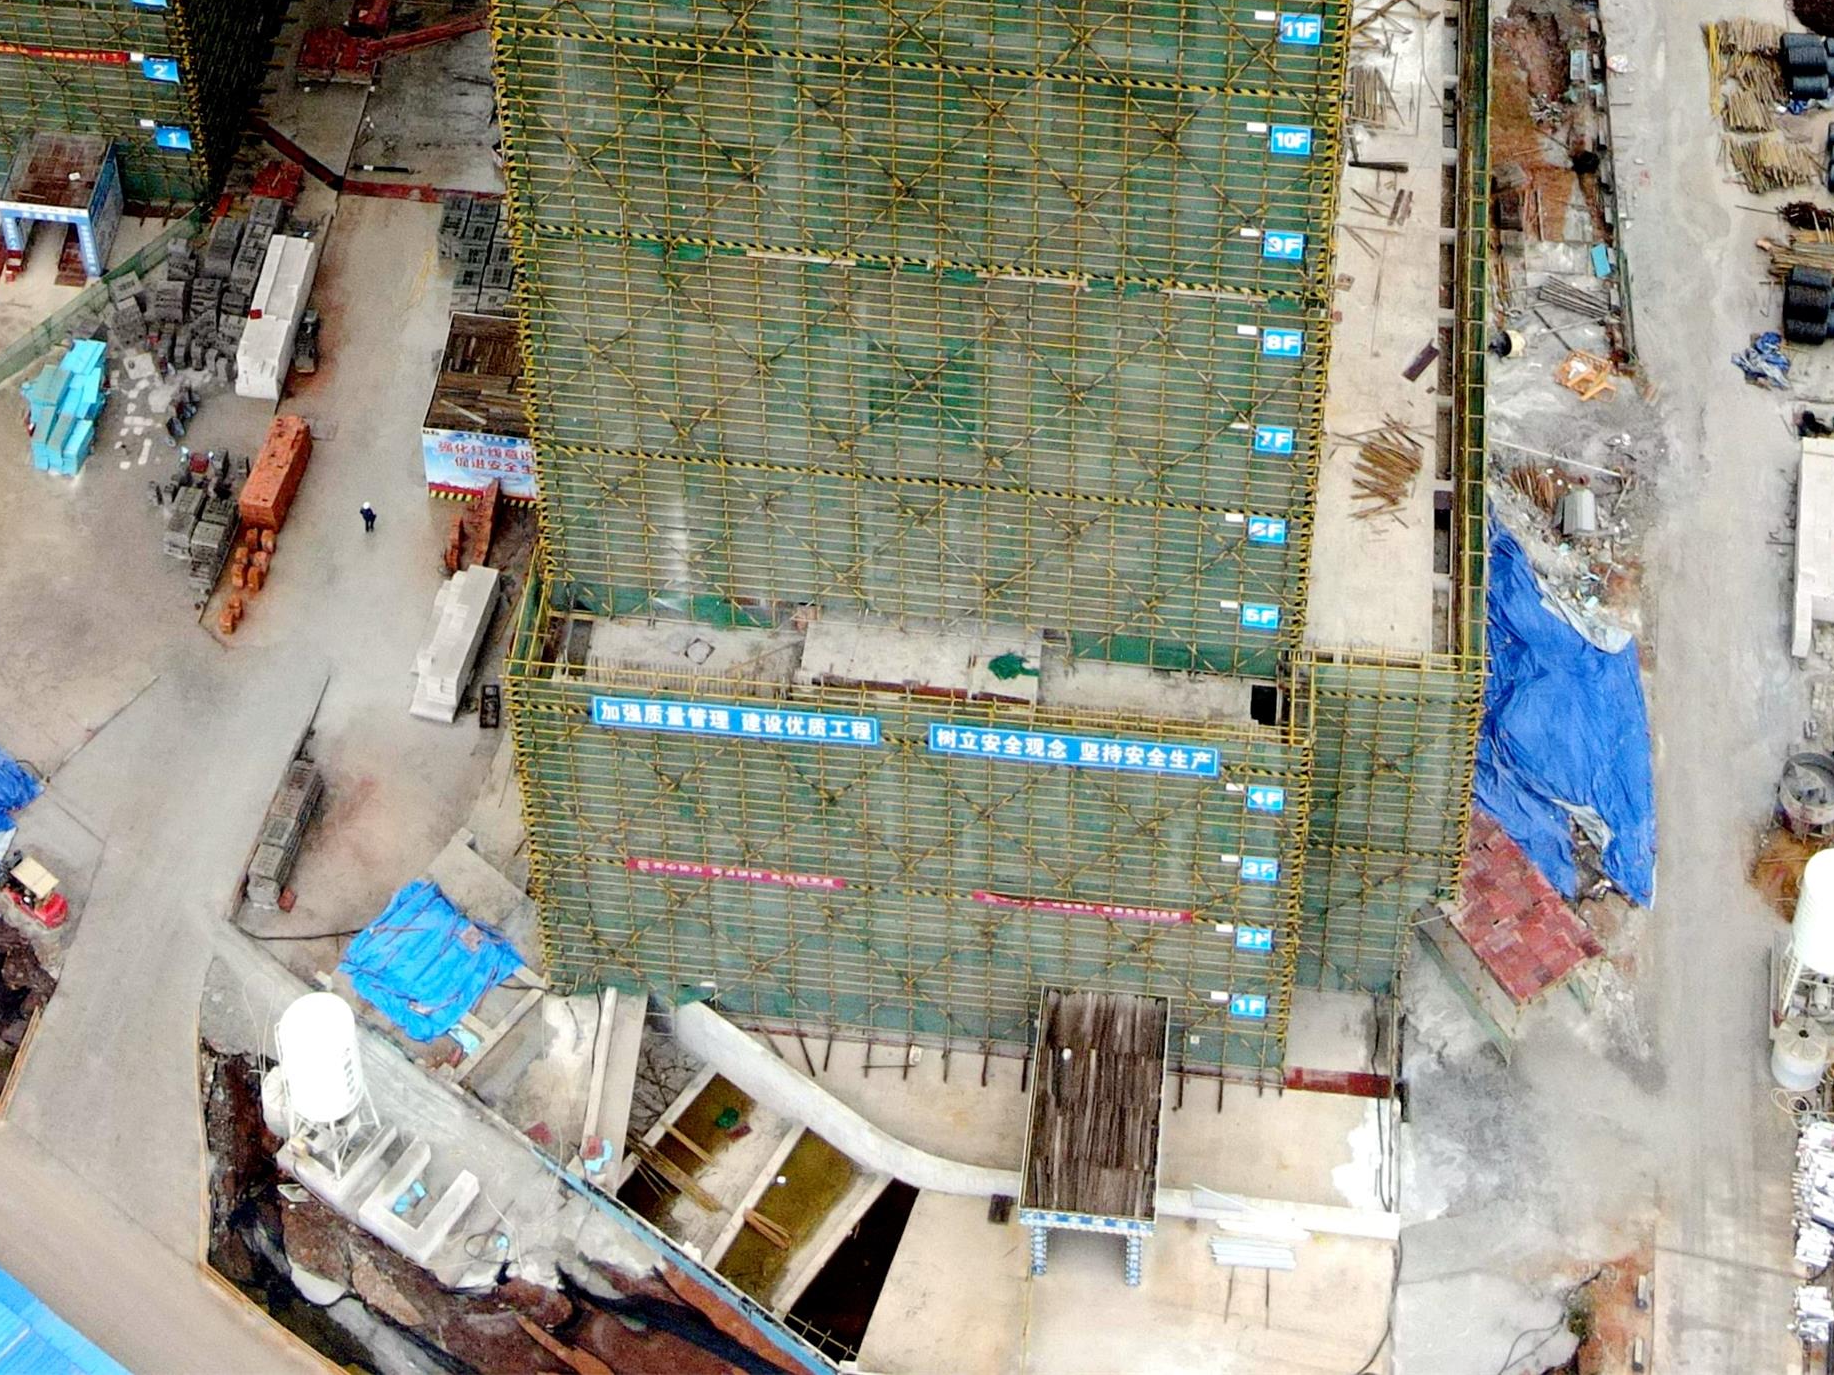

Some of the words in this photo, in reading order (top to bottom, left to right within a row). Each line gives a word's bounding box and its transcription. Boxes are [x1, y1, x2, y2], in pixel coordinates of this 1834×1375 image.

[1282, 20, 1318, 38] 11F
[1274, 132, 1309, 149] 10F
[1266, 236, 1300, 254] 9F
[1266, 334, 1300, 352] 8F
[1259, 430, 1290, 447] 7F
[1251, 523, 1282, 537] 6F
[1245, 610, 1276, 624] 5F
[598, 700, 731, 732] 加强质量管理
[740, 710, 873, 743] 建设优质工程
[933, 726, 1069, 763] 树立安全观念
[1078, 735, 1214, 773] 坚持安全生产
[1251, 790, 1283, 804] 4F
[1244, 863, 1275, 877] 3F
[1240, 931, 1269, 945] 2F
[1233, 999, 1262, 1014] 1F
